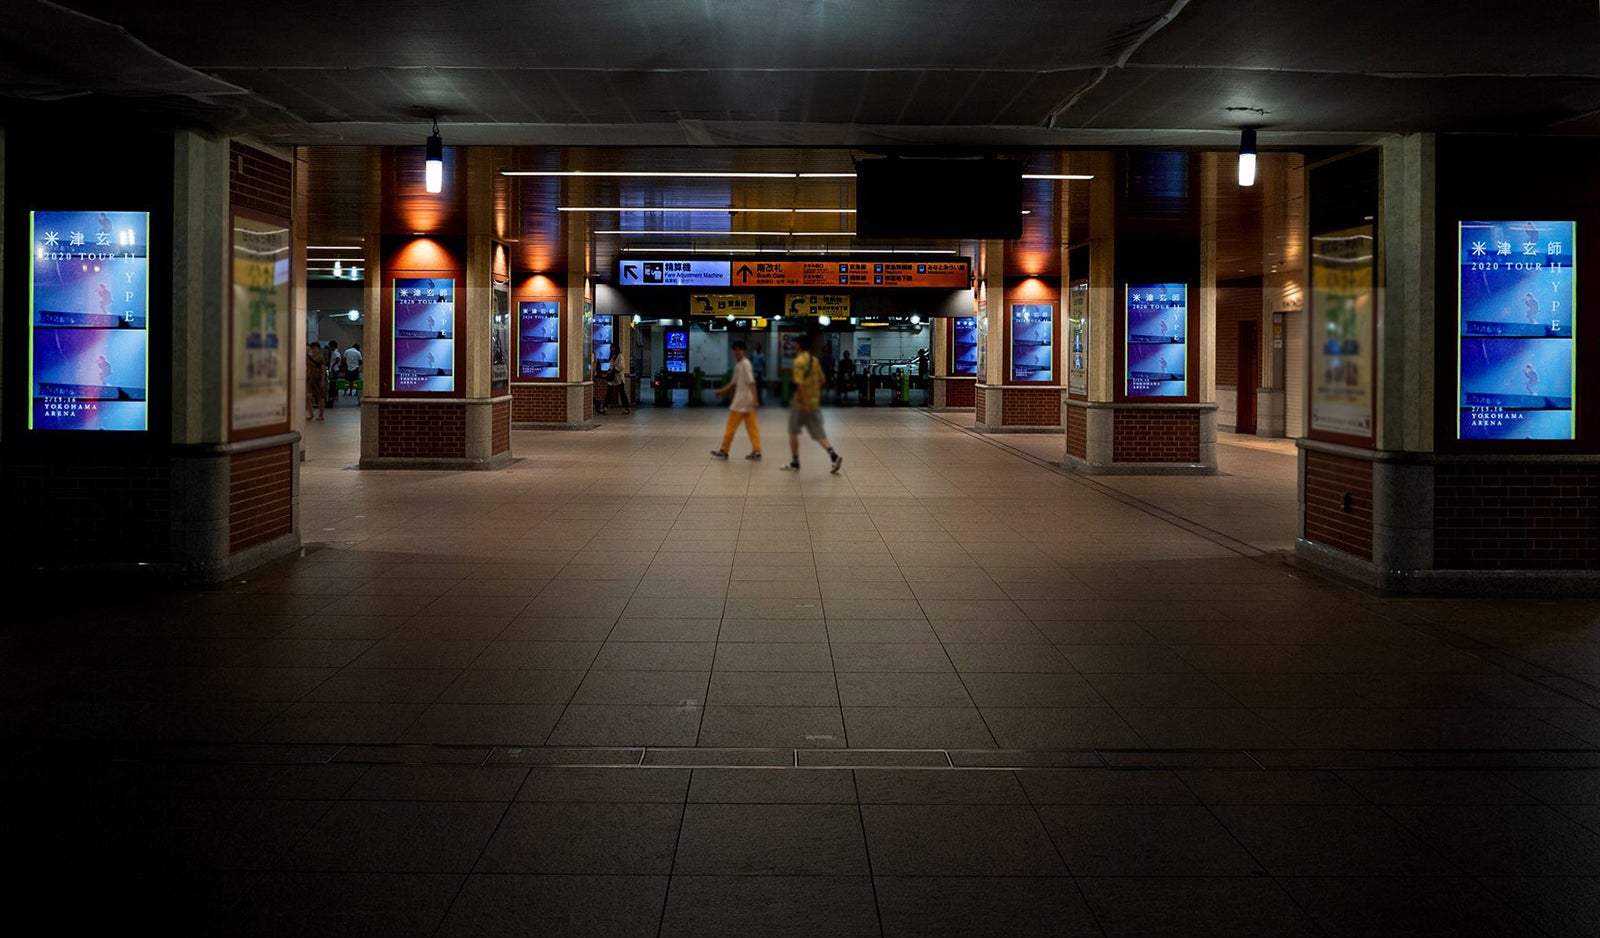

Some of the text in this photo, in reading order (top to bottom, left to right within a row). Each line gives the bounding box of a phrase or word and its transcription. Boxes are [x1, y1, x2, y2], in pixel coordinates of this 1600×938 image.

[44, 230, 136, 247] 米津玄
[44, 253, 116, 261] 2020 TOUR
[1471, 240, 1563, 257] 米津玄師
[1471, 262, 1542, 270] 2020 TOUR
[124, 252, 136, 323] HYPE
[1550, 262, 1562, 332] HYPE
